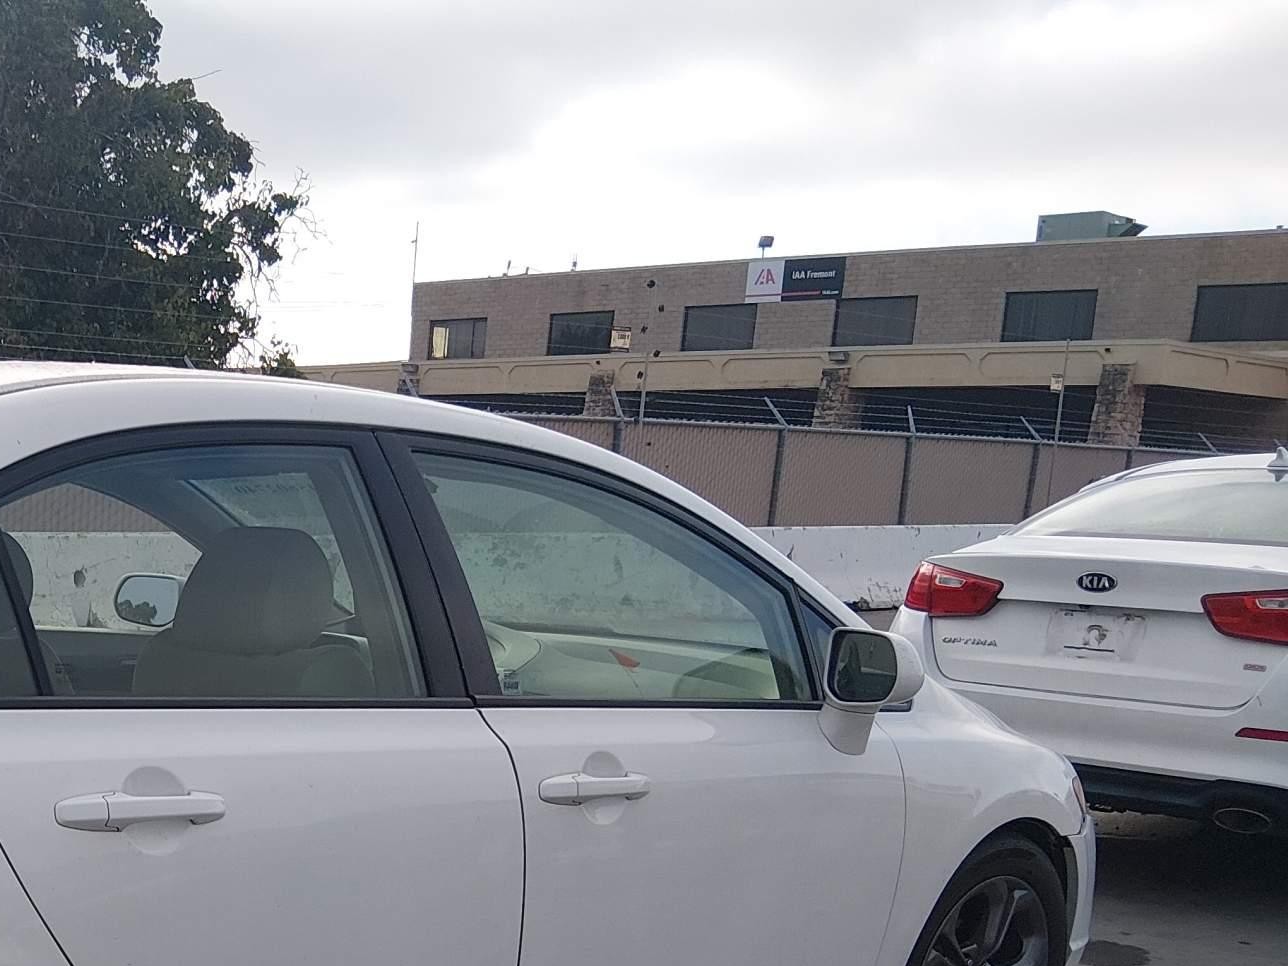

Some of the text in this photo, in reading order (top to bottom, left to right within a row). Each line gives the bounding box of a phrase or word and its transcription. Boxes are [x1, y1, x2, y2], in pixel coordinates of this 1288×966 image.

[792, 269, 836, 280] IAA Fremont
[1081, 575, 1109, 589] KIA
[941, 635, 998, 648] OPTIMA
